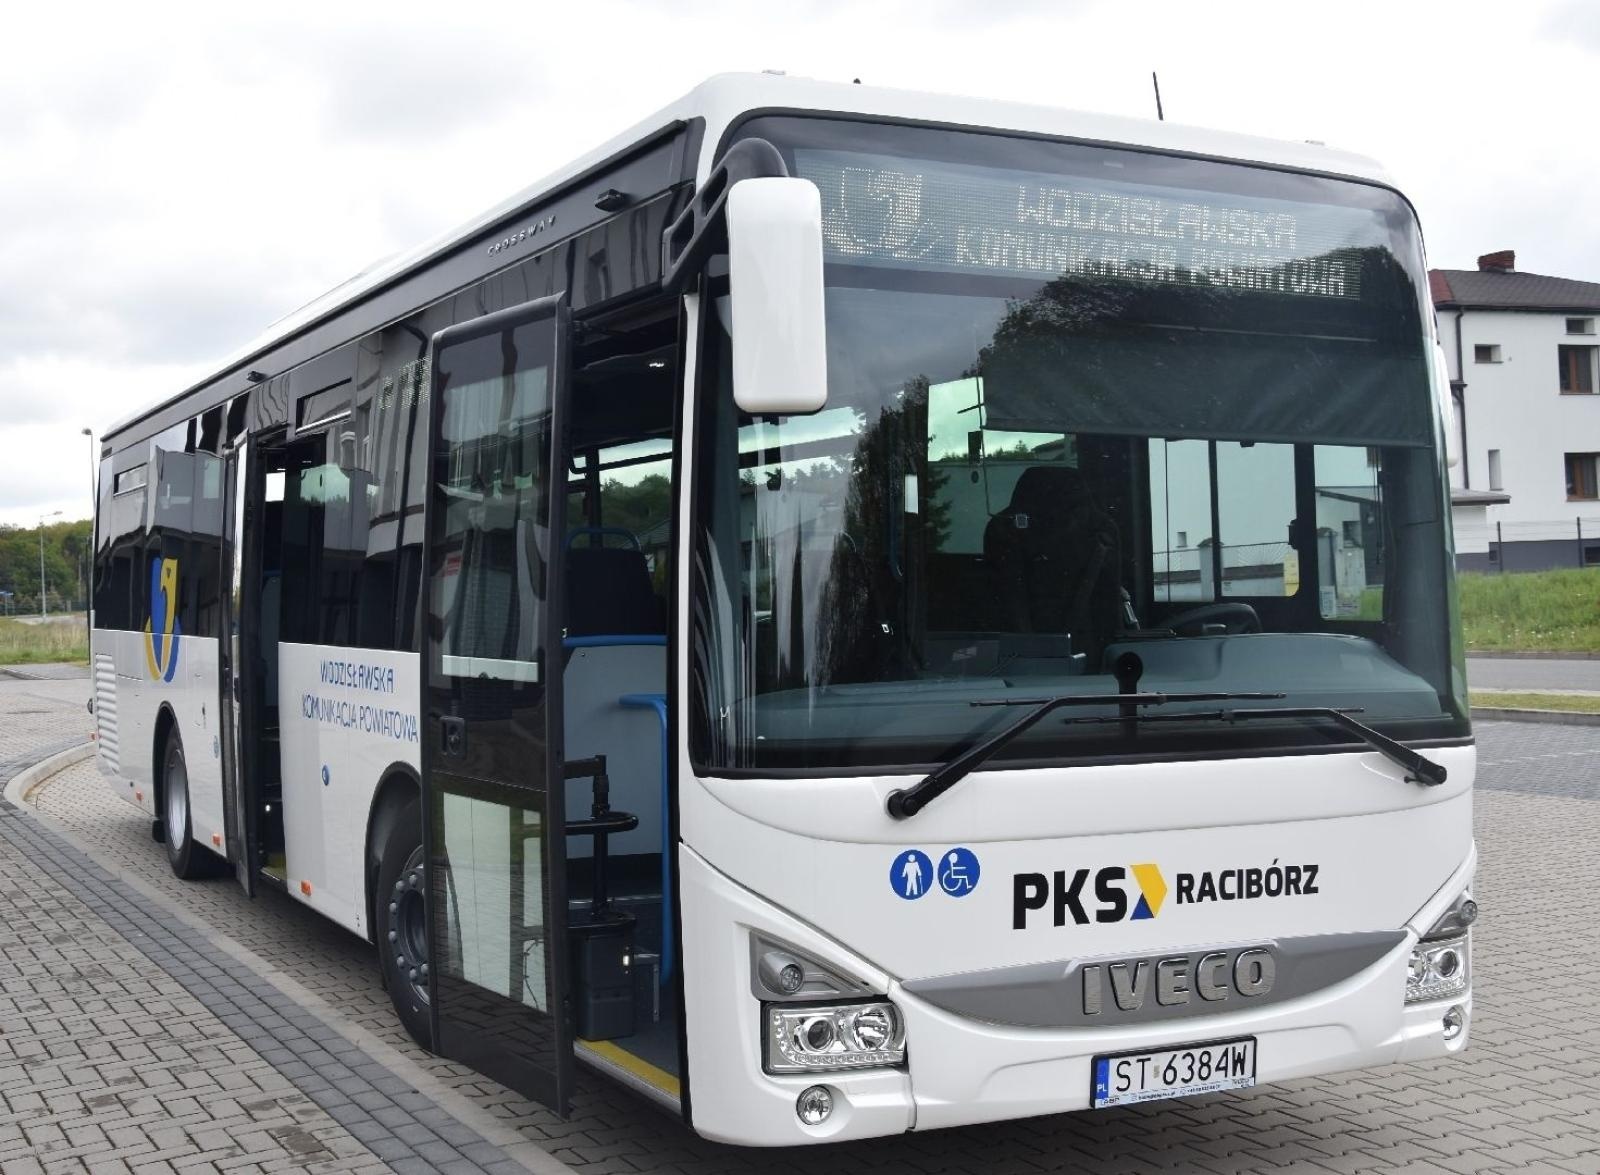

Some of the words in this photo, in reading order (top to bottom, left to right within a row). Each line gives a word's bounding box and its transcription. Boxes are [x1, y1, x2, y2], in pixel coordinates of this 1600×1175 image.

[1018, 185, 1297, 249] WODZISŁAWSKA
[320, 660, 394, 694] WODZISŁAWSKA
[302, 694, 358, 729] KOMUNIKACJA
[360, 706, 418, 743] POWIATOWA
[1012, 865, 1128, 930] PKS
[1176, 858, 1319, 905] RACIBÓRZ
[1081, 948, 1276, 1016] IVECO
[1096, 1083, 1108, 1093] PL
[1116, 1057, 1152, 1092] ST
[1162, 1044, 1248, 1086] 6384W
